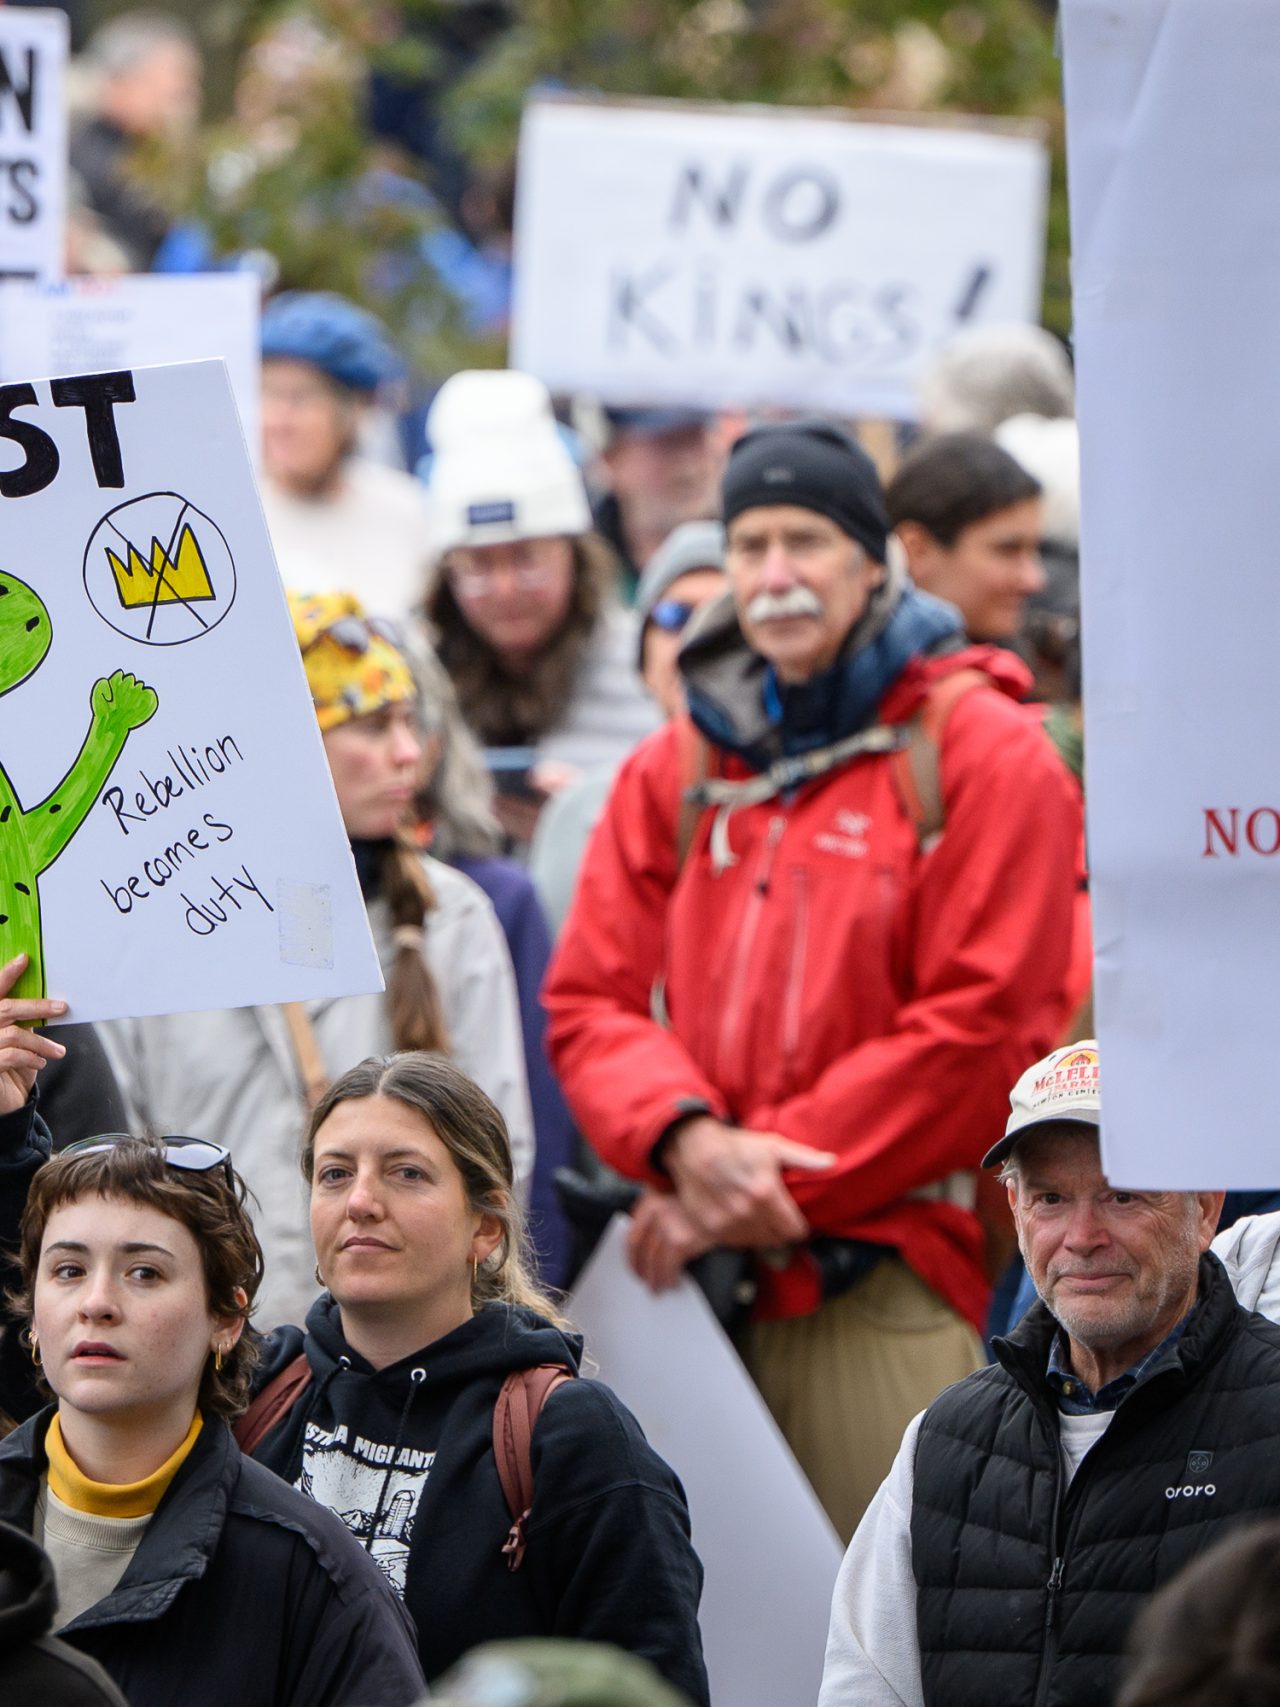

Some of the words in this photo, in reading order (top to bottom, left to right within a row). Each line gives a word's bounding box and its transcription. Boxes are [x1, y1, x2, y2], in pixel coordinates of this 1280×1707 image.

[668, 162, 843, 244] NO
[101, 735, 244, 835] Rebellion
[100, 813, 233, 913] becomes
[179, 864, 274, 935] duty
[1165, 1484, 1216, 1499] ororo
